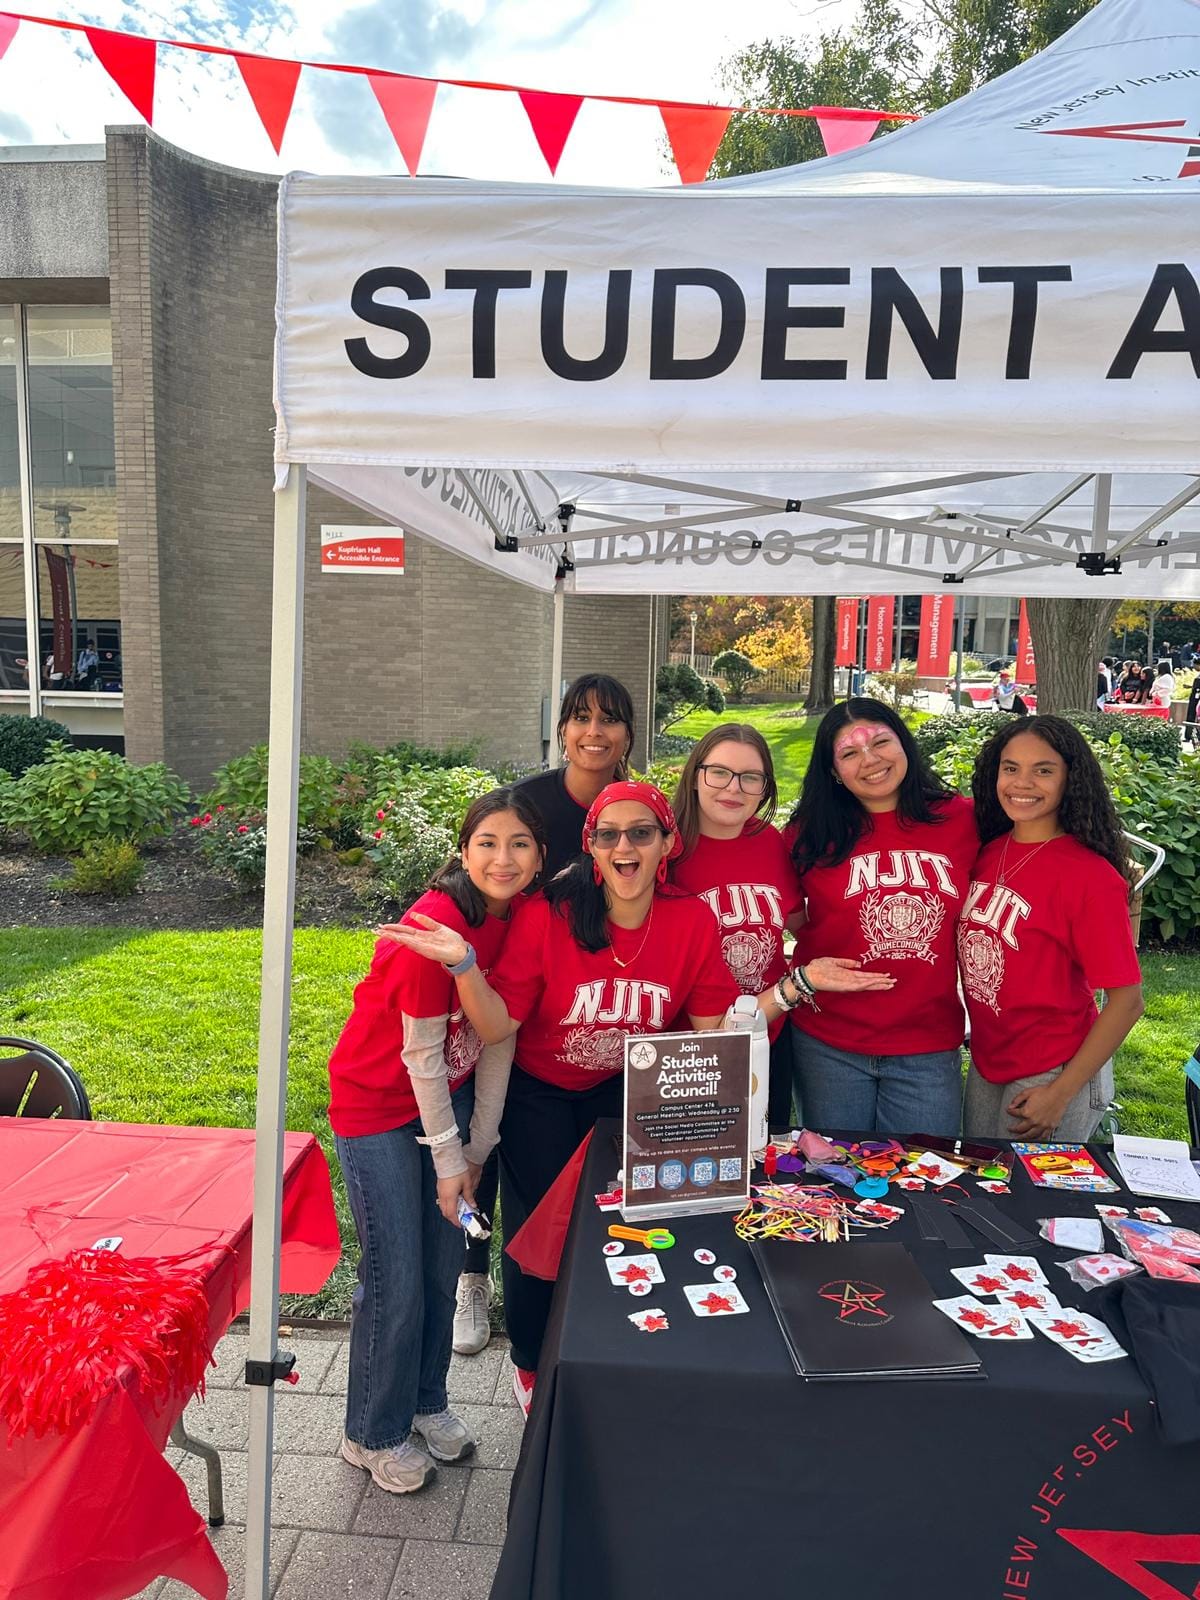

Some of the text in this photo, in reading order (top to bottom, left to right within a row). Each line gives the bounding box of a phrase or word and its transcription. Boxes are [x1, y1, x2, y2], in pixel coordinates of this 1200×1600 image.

[1014, 111, 1060, 130] New
[1050, 84, 1126, 112] Jersey
[344, 263, 1200, 381] STUDENT A
[842, 614, 851, 650] Computing
[874, 606, 886, 666] Honors College
[929, 594, 943, 659] Management
[843, 850, 959, 899] NJIT
[876, 940, 923, 951] HOMECOMING
[559, 978, 671, 1029] NJIT
[661, 1054, 718, 1070] Student
[679, 1042, 700, 1053] Join
[656, 1069, 722, 1085] Activities
[660, 1081, 718, 1098] Council!
